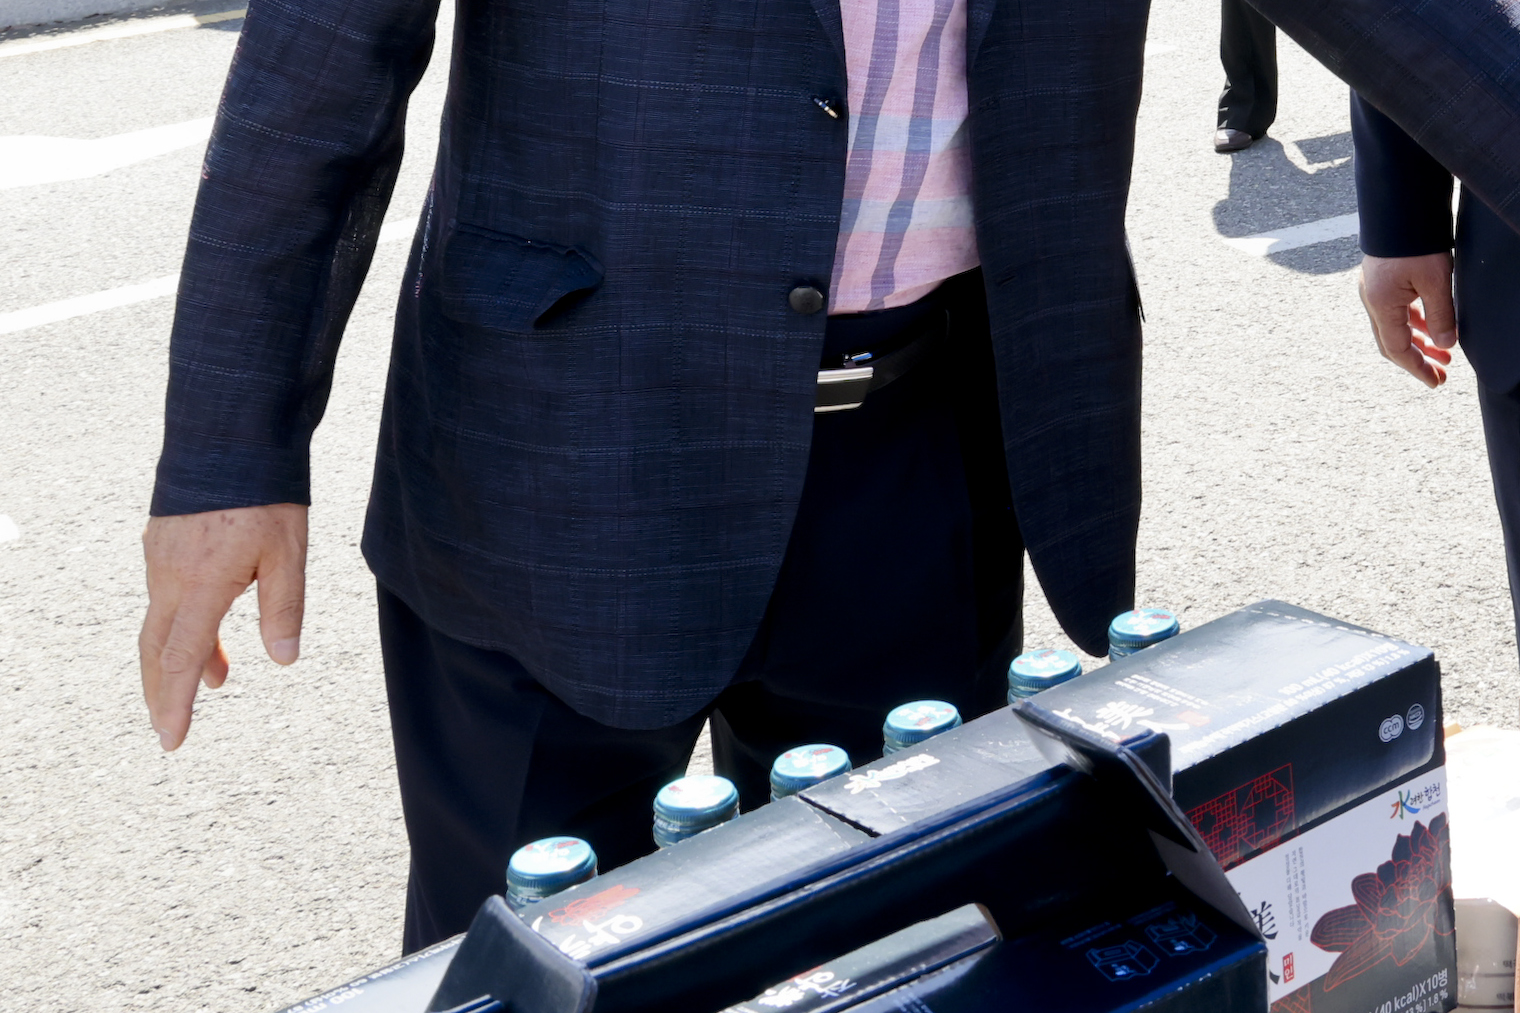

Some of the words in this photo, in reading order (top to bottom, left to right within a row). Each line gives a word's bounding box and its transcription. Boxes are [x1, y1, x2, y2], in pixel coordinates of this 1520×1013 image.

[1383, 722, 1399, 734] ccm
[1424, 782, 1441, 801] 합천
[1284, 953, 1294, 981] 미인
[1428, 993, 1439, 1006] 1.8
